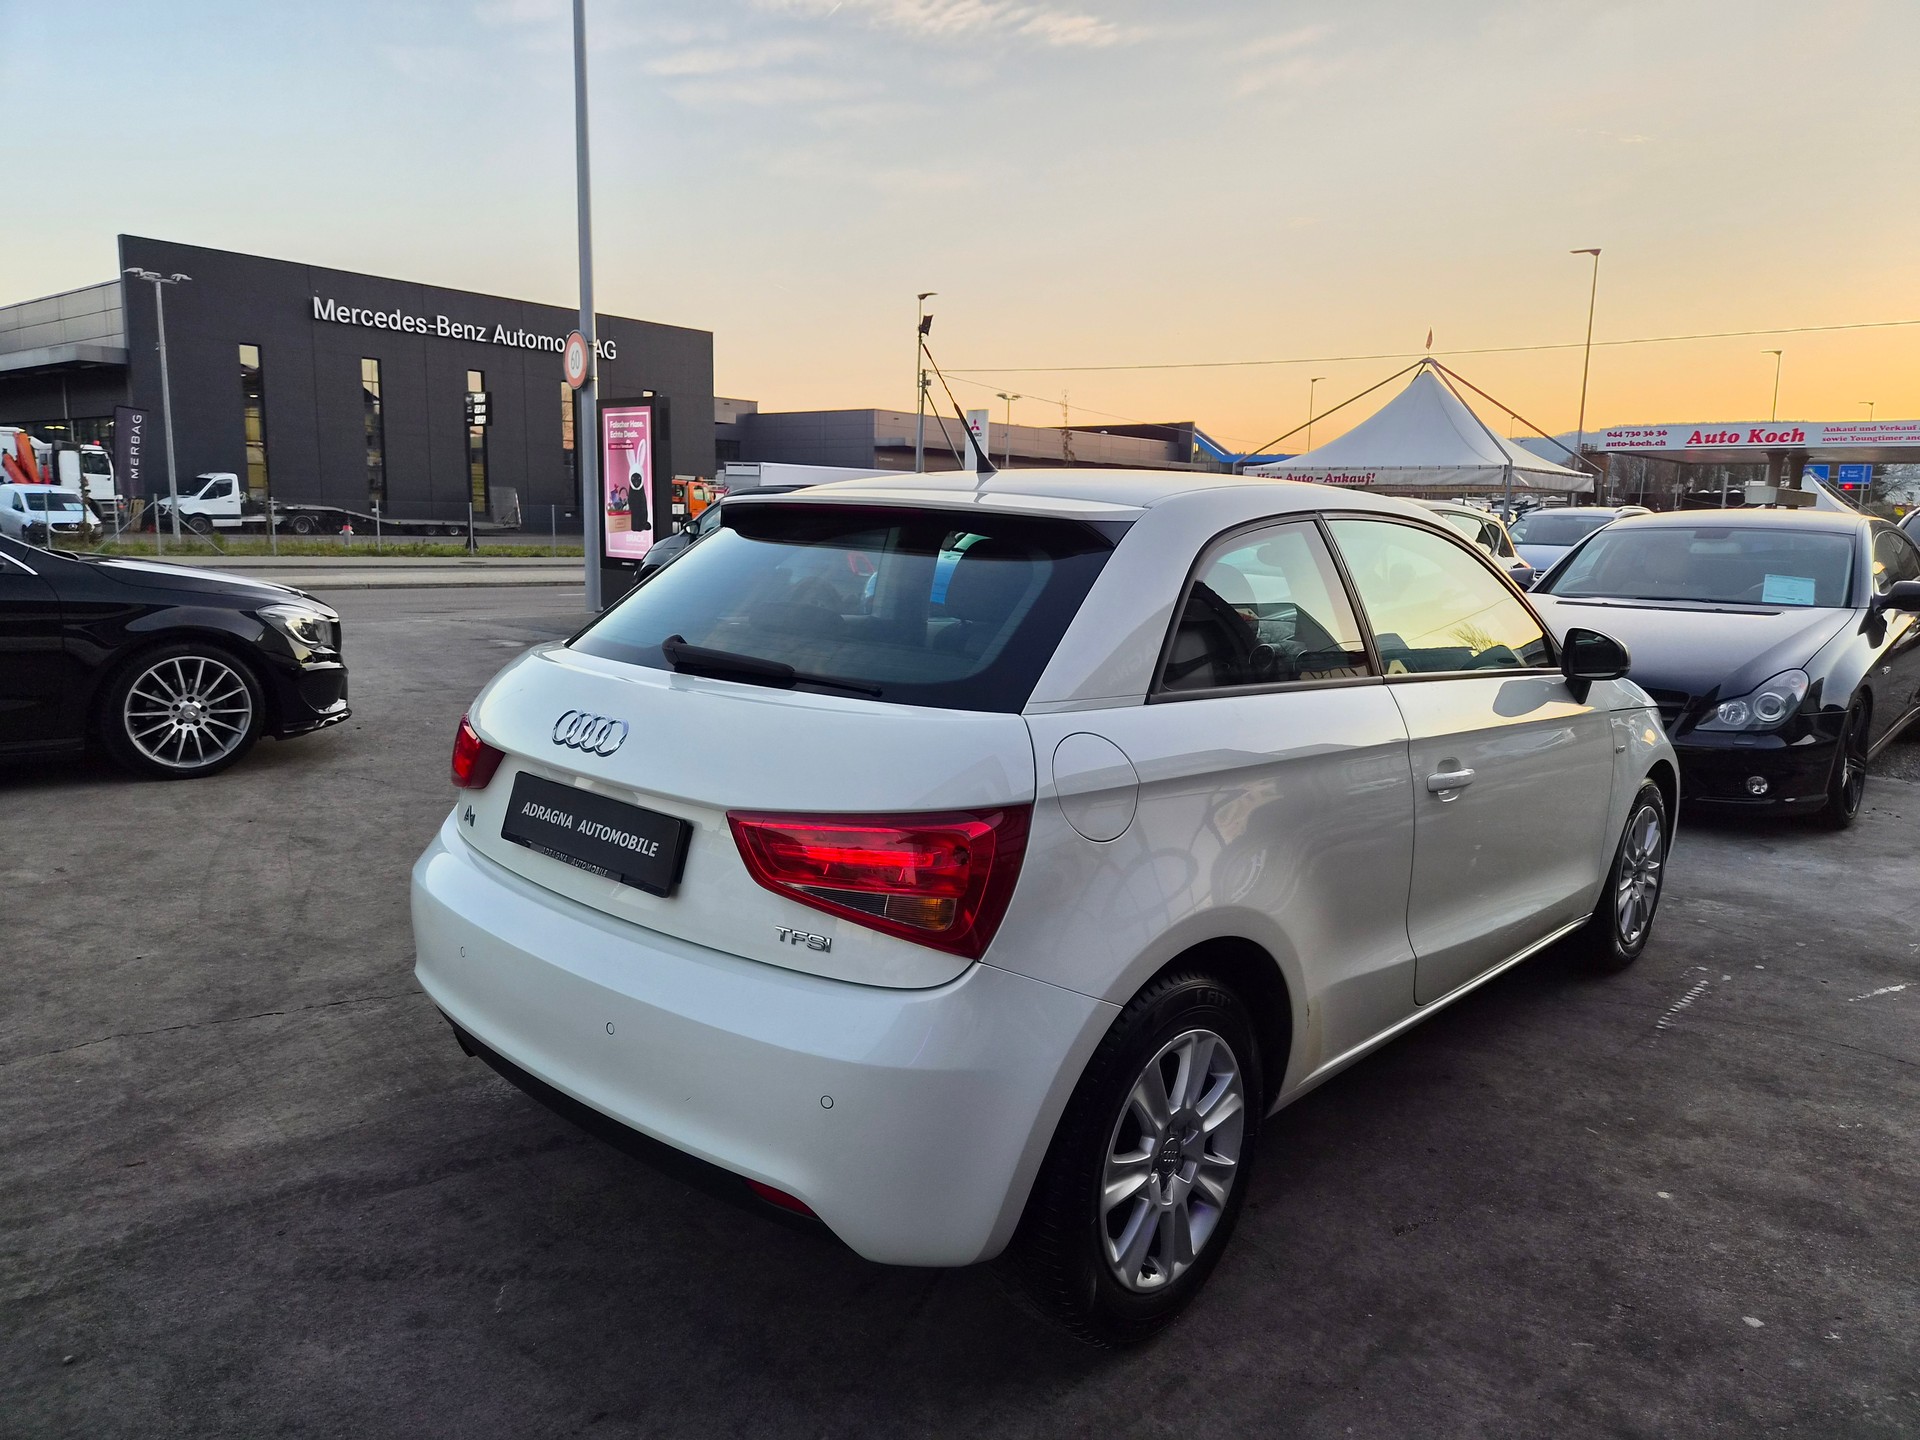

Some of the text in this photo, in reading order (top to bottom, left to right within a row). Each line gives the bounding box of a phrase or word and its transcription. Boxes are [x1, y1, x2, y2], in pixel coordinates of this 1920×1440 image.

[313, 296, 617, 360] Mercedes-Benz Automo AG
[570, 349, 581, 370] 60
[130, 414, 143, 479] MERBAG
[1686, 428, 1806, 445] Auto Koch
[1850, 435, 1904, 443] Youngtimer
[1286, 473, 1314, 483] Auto
[1324, 473, 1376, 485] Ankauf!
[521, 801, 660, 858] ADRAGNA AUTOMOBILE
[571, 858, 609, 878] AUTOMOBILE
[775, 925, 832, 953] TFSI
